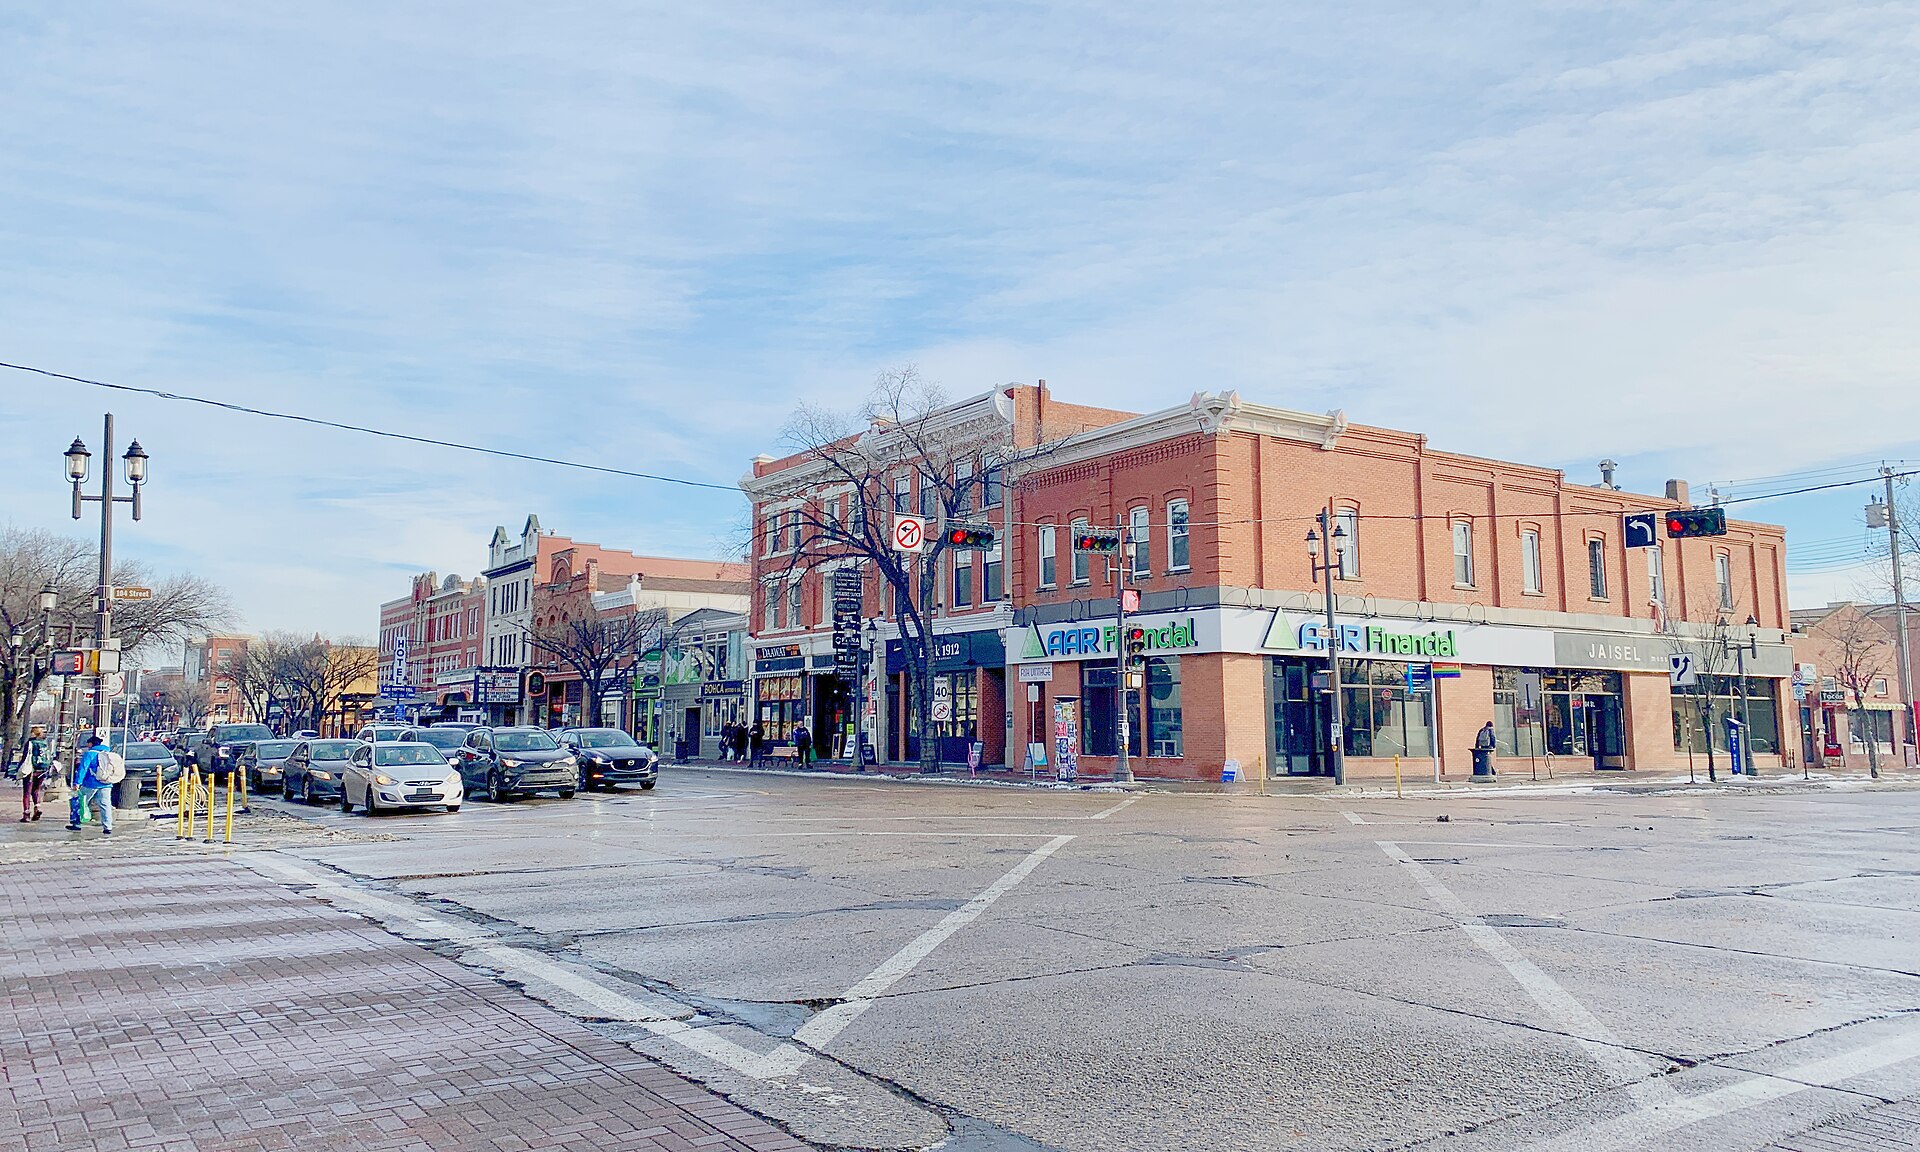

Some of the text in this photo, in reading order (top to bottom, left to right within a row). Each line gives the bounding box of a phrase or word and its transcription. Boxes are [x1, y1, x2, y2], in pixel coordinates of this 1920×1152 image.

[1047, 617, 1198, 655] AAR Fincial
[1366, 625, 1458, 657] Financial
[942, 643, 959, 656] 1912
[1588, 643, 1641, 661] JAISEL
[74, 654, 82, 671] 3
[396, 640, 404, 684] HOTEL
[935, 687, 947, 697] 40
